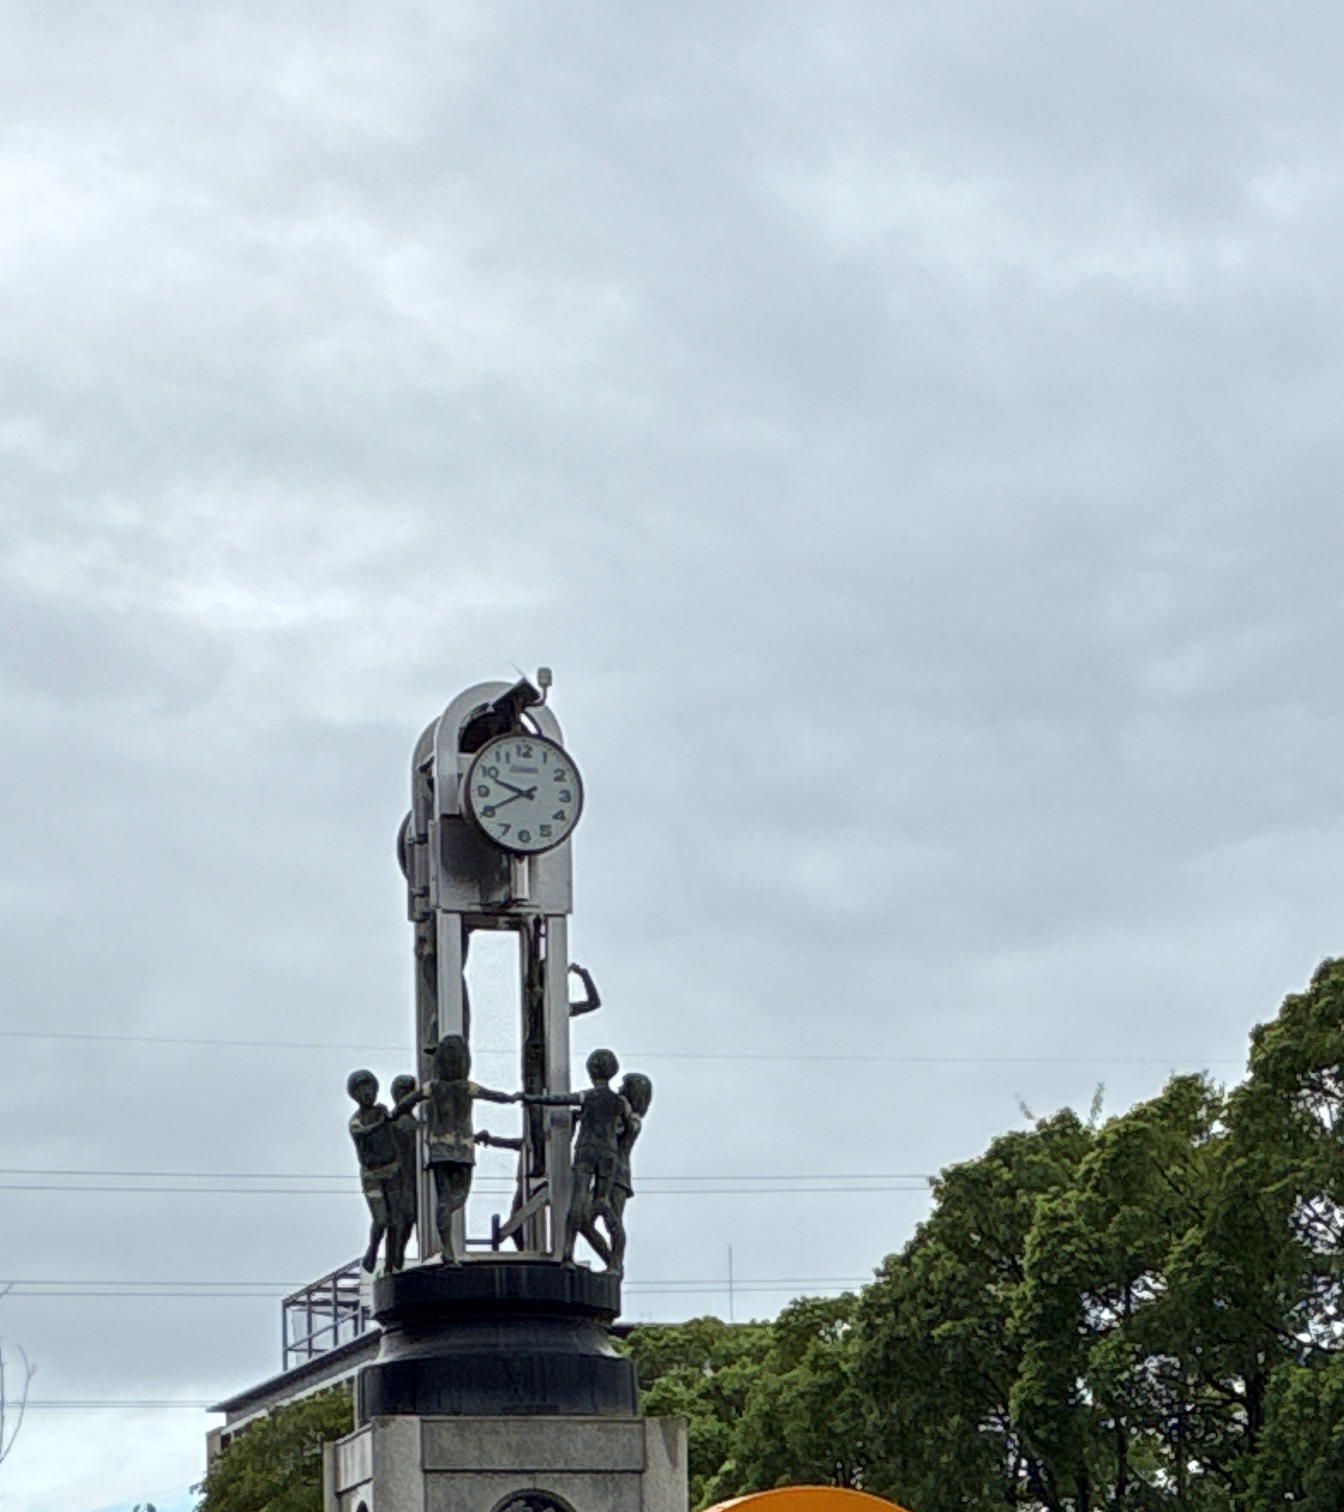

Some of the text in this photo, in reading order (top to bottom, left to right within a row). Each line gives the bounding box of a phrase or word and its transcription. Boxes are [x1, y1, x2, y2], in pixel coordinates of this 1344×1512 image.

[495, 751, 510, 764] 11
[516, 744, 533, 758] 12
[480, 765, 499, 779] 10
[553, 768, 566, 782] 2
[477, 784, 490, 798] 9
[558, 789, 571, 803] 3
[552, 809, 566, 821] 4
[498, 823, 511, 836] 7
[518, 829, 531, 843] 6
[539, 824, 552, 837] 5
